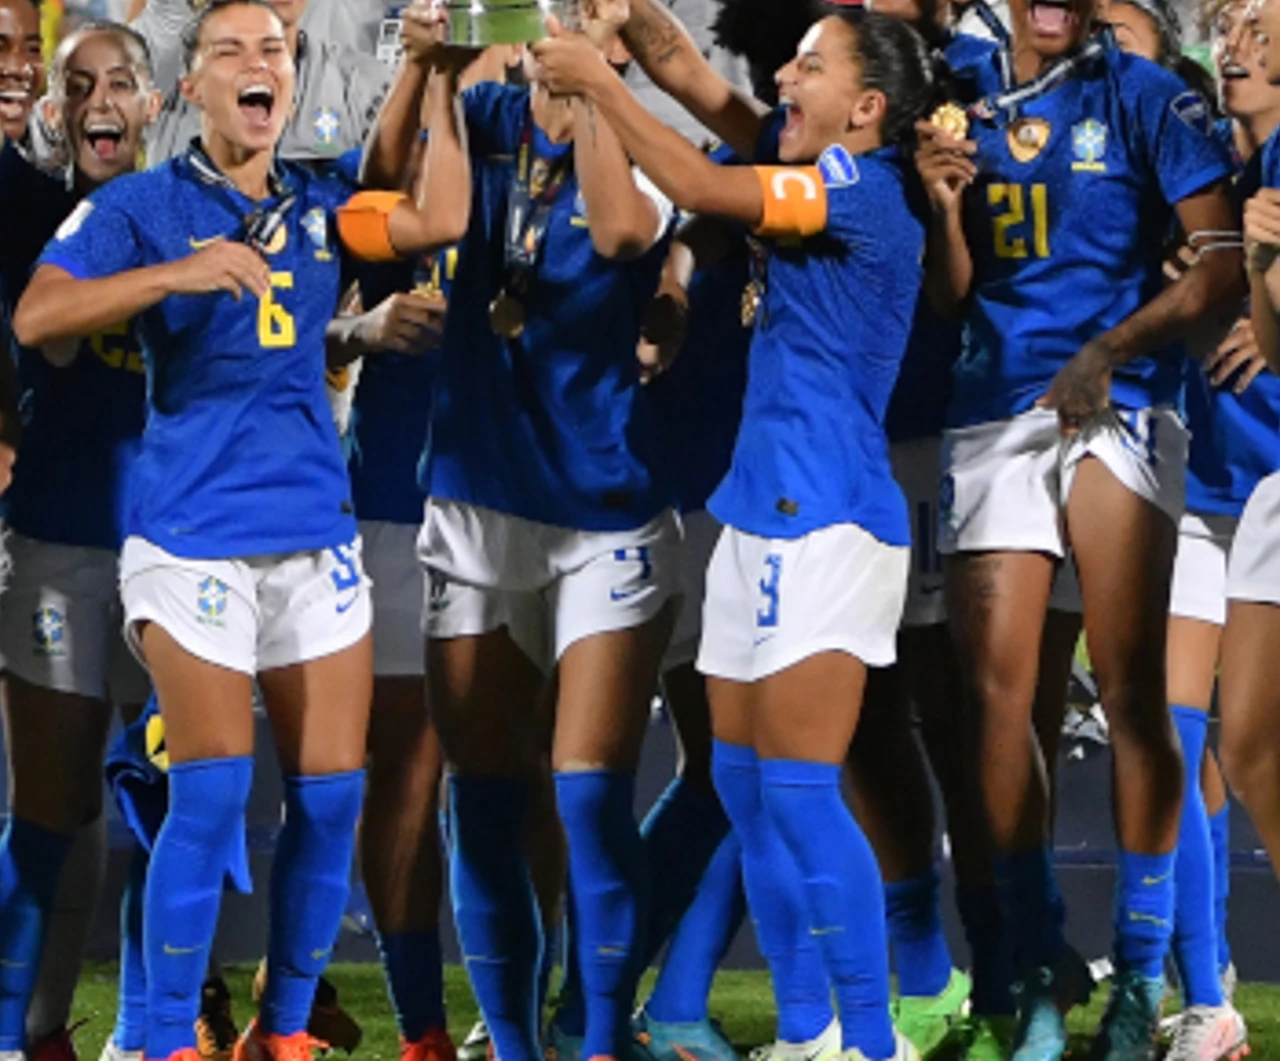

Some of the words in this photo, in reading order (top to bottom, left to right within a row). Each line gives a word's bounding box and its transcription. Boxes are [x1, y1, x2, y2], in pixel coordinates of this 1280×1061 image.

[771, 170, 817, 200] C
[987, 183, 1051, 258] 21
[259, 272, 296, 348] 6
